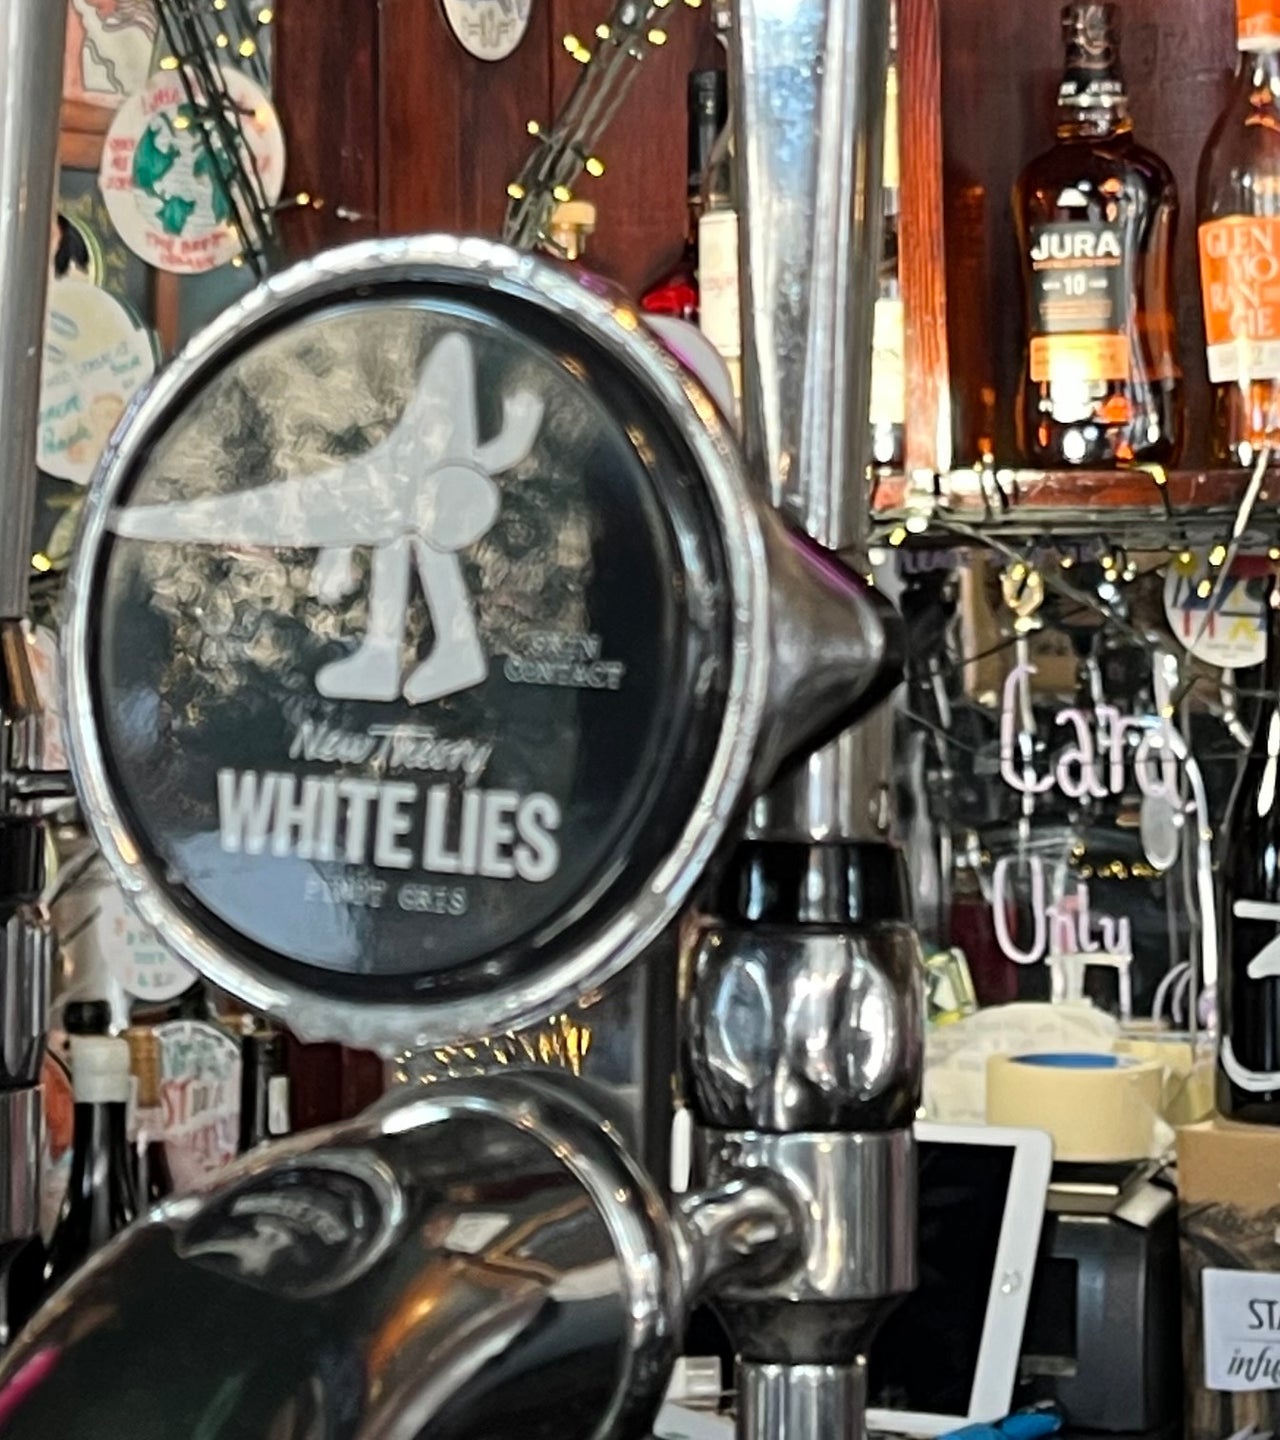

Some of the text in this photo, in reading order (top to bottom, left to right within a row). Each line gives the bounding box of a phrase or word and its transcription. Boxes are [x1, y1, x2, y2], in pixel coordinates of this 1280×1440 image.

[1030, 232, 1122, 262] JURA
[1206, 225, 1273, 258] GLEN
[1063, 274, 1087, 297] 10
[503, 658, 626, 690] CONTACT
[288, 717, 494, 788] New Theory
[217, 768, 562, 882] WHITE LIES
[396, 880, 468, 916] GRIS
